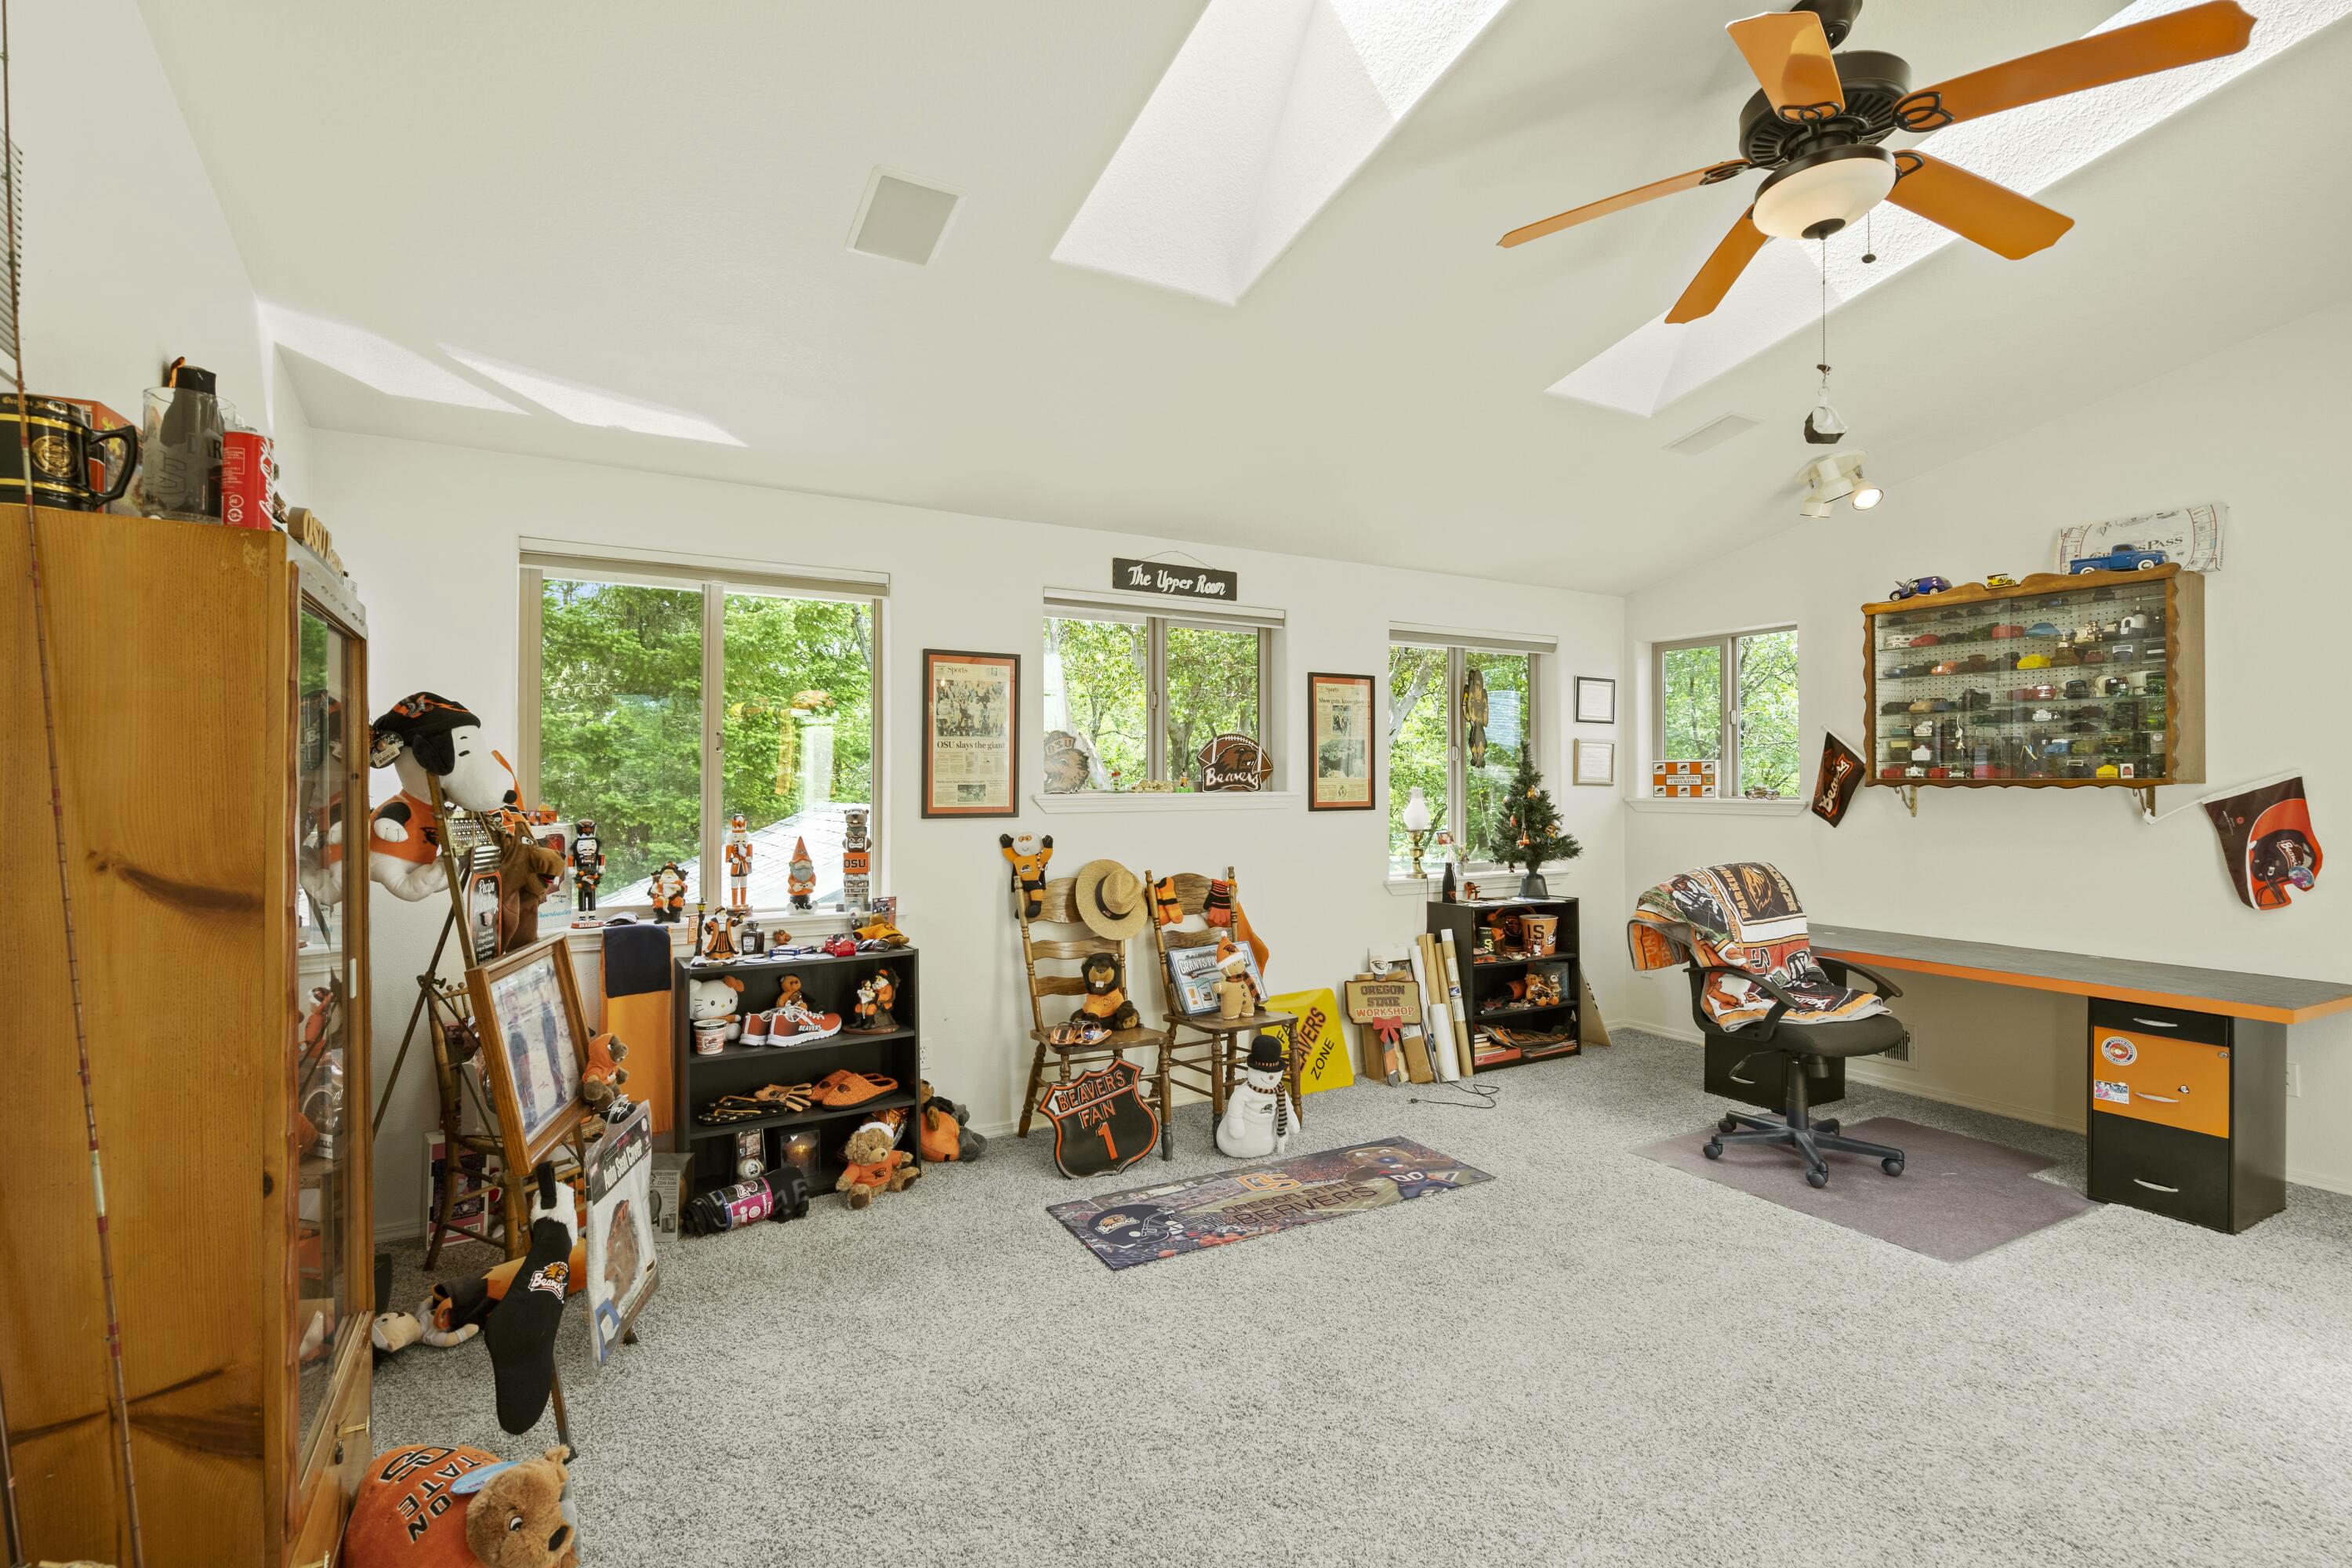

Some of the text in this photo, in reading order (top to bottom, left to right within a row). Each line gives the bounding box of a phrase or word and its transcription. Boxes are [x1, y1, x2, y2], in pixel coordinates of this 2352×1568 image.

[303, 510, 327, 558] OSU
[2147, 535, 2183, 550] PASS
[1128, 564, 1226, 595] The Upper Room
[947, 666, 967, 674] Sports
[956, 741, 973, 750] slays
[987, 742, 1005, 750] giant
[1205, 768, 1259, 790] Beavers
[844, 859, 866, 868] OSU
[478, 879, 495, 896] Recipe
[1178, 958, 1207, 974] GRANTS
[1360, 985, 1405, 996] OREGON
[1367, 996, 1400, 1007] STATE
[1356, 1007, 1414, 1017] WORKSHOP
[1311, 1037, 1334, 1080] ZONE
[1055, 1070, 1126, 1112] BEAVERS
[1079, 1099, 1116, 1129] FAN
[1097, 1122, 1118, 1160] 1
[604, 1138, 643, 1191] Auto Seat Cover
[1388, 1171, 1425, 1182] 00
[1221, 1180, 1361, 1214] OREGON STATE
[1232, 1185, 1378, 1225] BEAVERS
